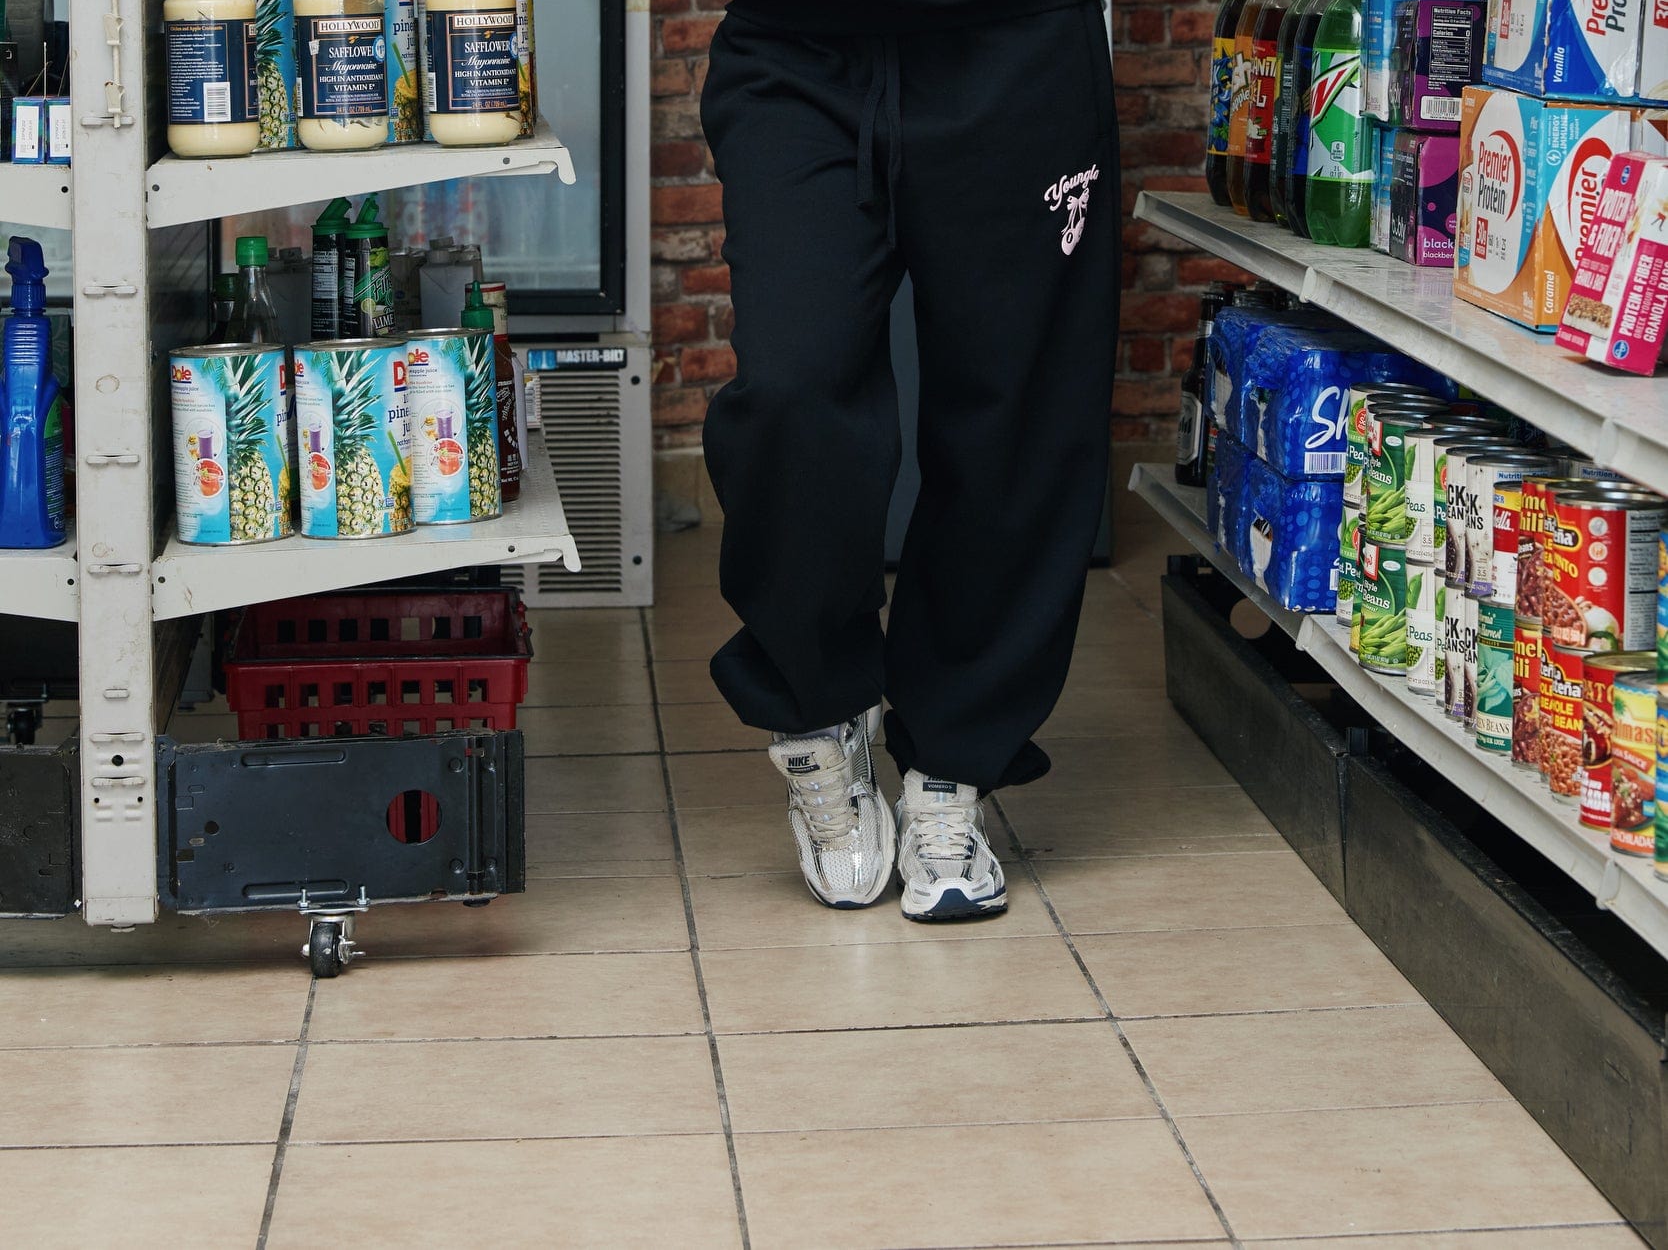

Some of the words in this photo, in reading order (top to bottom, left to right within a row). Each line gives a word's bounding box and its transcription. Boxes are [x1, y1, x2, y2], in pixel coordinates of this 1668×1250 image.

[320, 19, 380, 31] HOLLYWOOD
[456, 16, 513, 26] HOLLYWOOD
[326, 60, 377, 75] Mayonnaise
[461, 55, 511, 69] Mayonnaise
[1553, 46, 1565, 83] Vanilla
[345, 73, 384, 82] ANTIOXIDANT
[455, 70, 472, 78] HIGH
[482, 68, 517, 77] ANTIOXIDANT
[334, 83, 368, 92] VITAMIN
[470, 79, 503, 87] VITAMIN
[1560, 113, 1568, 149] IMMUNE
[1477, 141, 1512, 184] Premier
[1044, 164, 1100, 212] Youngla
[1477, 173, 1506, 215] Protein
[1597, 188, 1633, 222] PROTEIN
[1392, 212, 1407, 245] bubly
[1592, 223, 1621, 258] FIBER
[1634, 254, 1654, 285] FIBER
[1544, 270, 1555, 314] Caramel
[1633, 285, 1643, 294] &
[1633, 316, 1647, 339] GREEK
[1640, 287, 1655, 315] YOGURT
[1649, 258, 1664, 286] COATED
[372, 314, 394, 330] LIME
[1618, 292, 1643, 336] PROTEIN
[1643, 294, 1668, 343] GRANOLA
[556, 350, 625, 363] MASTER-BILT
[171, 364, 193, 381] Dole
[1582, 468, 1613, 479] Nutrition
[1422, 535, 1432, 545] 3.5
[1409, 626, 1433, 642] Peas
[1486, 718, 1510, 734] BEANS
[788, 755, 811, 768] NIKE
[1623, 749, 1648, 770] SAUCE
